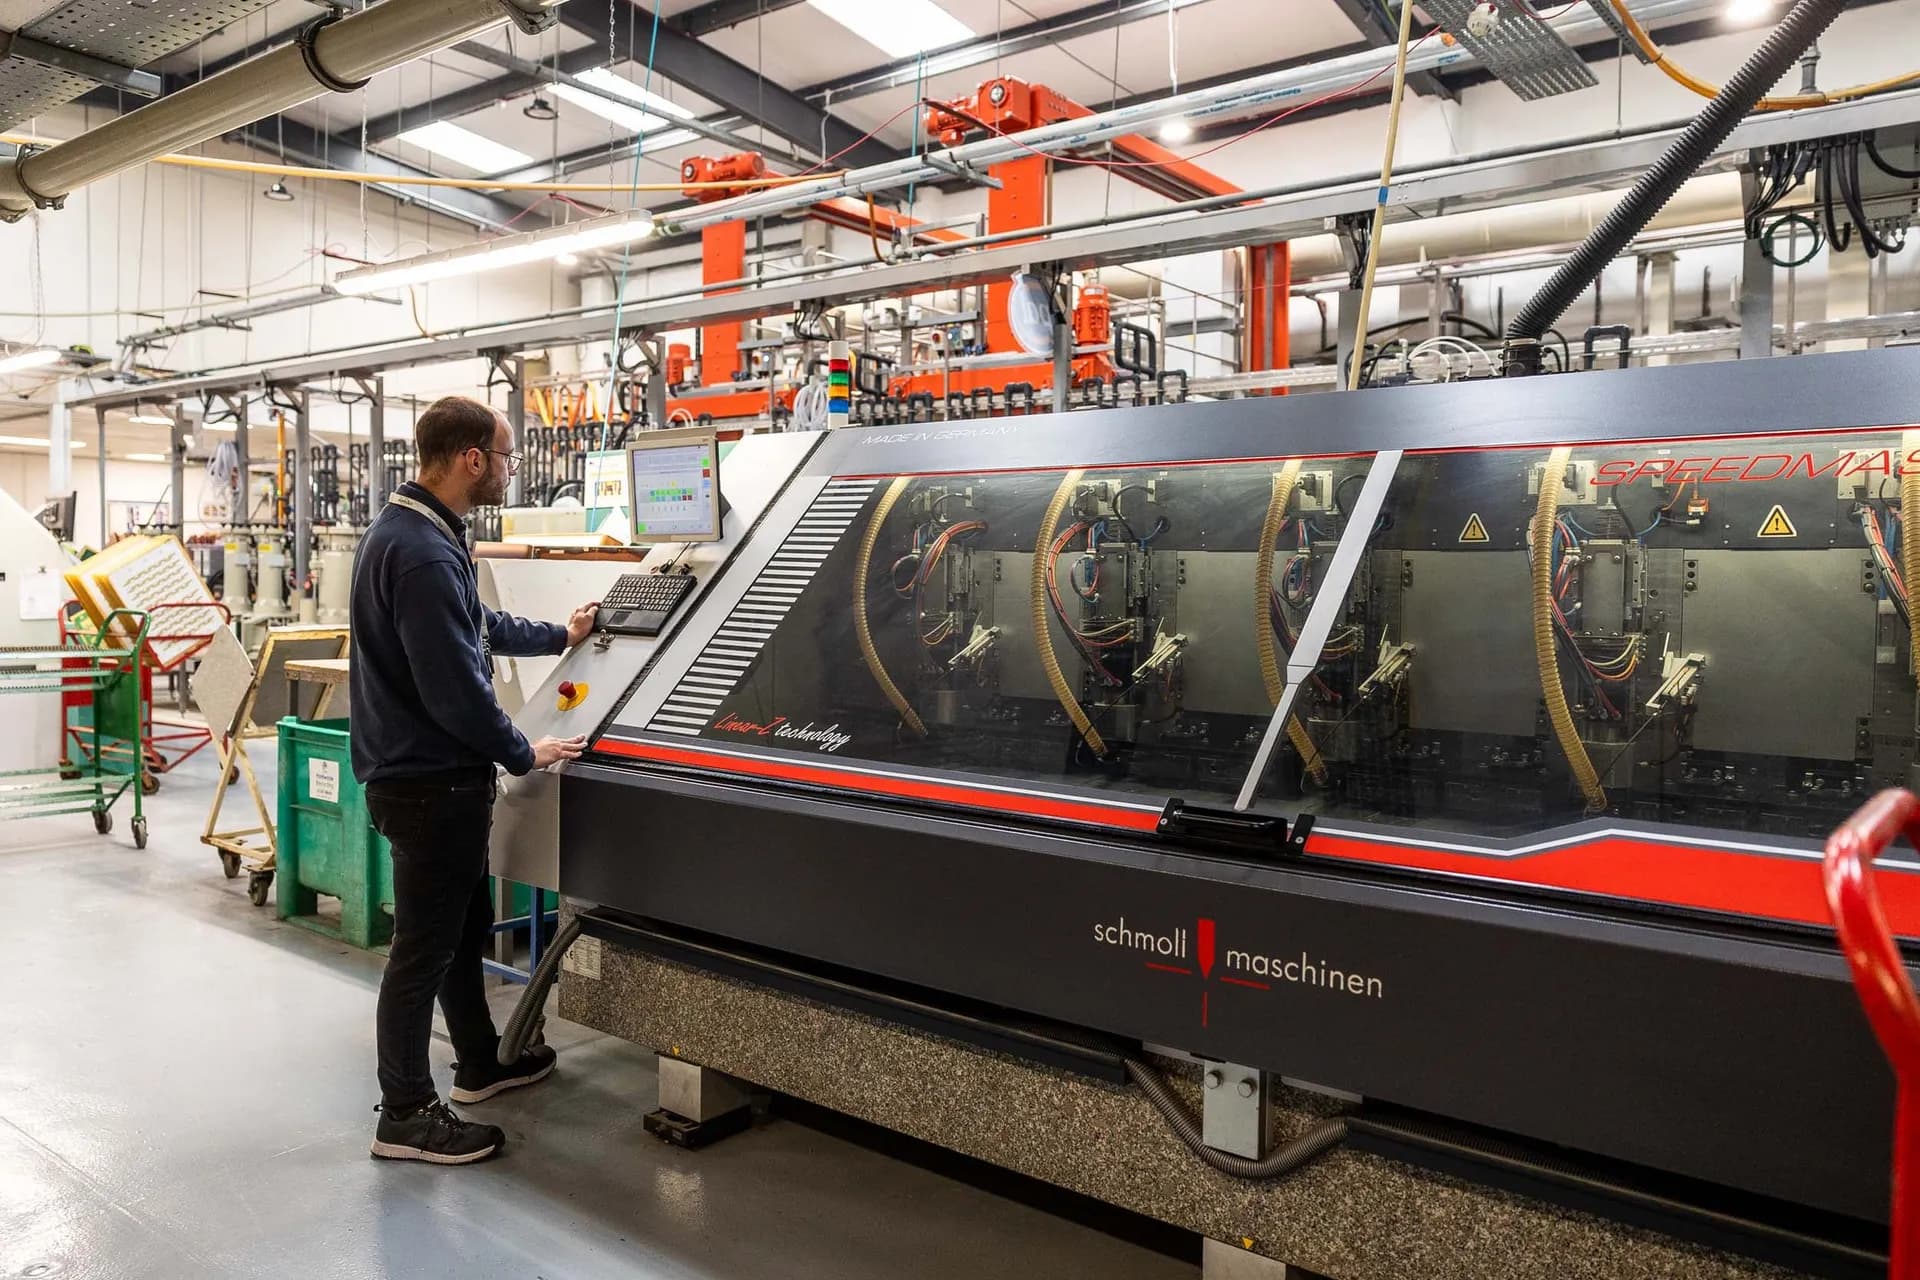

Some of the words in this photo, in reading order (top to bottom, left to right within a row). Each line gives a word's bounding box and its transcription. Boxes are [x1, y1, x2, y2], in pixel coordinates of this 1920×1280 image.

[862, 433, 912, 445] MADE
[913, 431, 933, 441] IN
[713, 712, 787, 735] Linear-Z
[774, 722, 852, 752] technology
[1094, 917, 1186, 958] schmoll
[1226, 950, 1383, 998] maschinen
